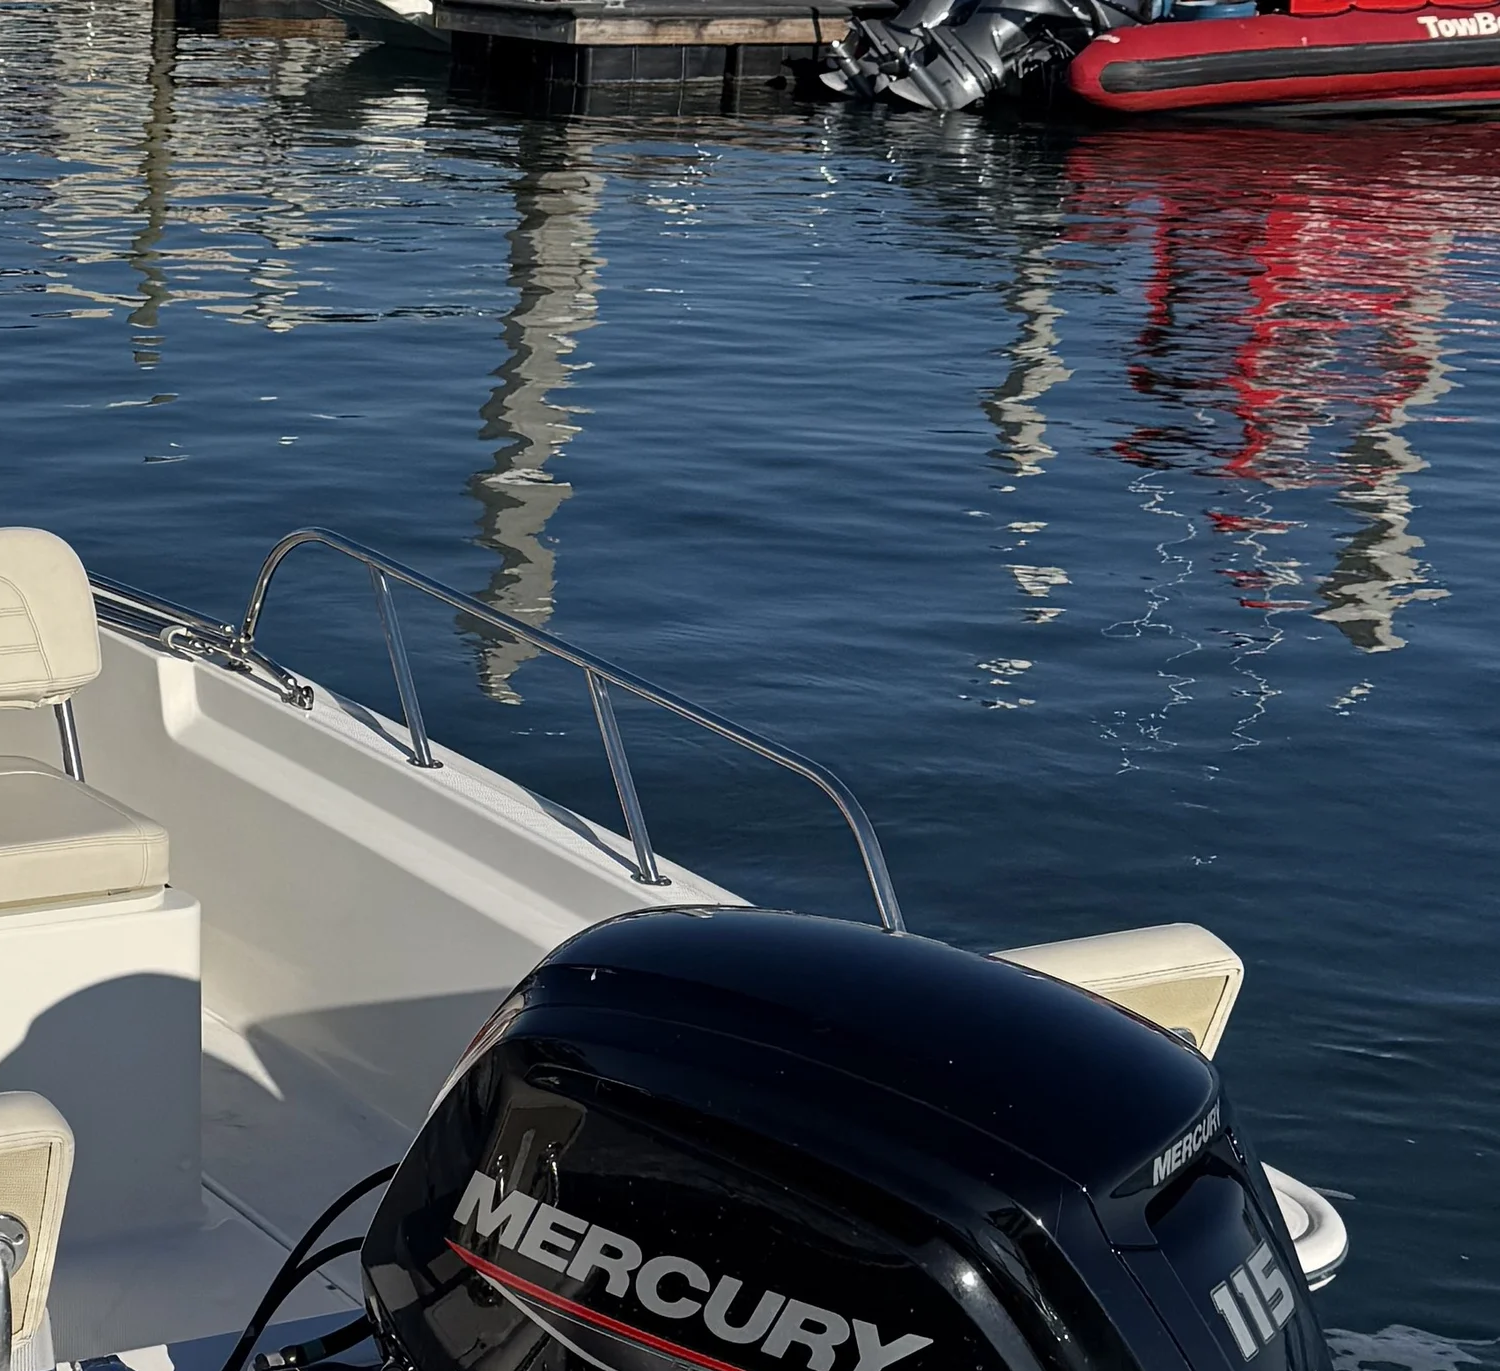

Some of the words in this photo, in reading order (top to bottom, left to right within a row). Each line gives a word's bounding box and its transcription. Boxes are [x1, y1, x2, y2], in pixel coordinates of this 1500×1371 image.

[1417, 12, 1500, 38] TowB
[1152, 1095, 1221, 1187] MERCURY
[1209, 1239, 1296, 1363] 115
